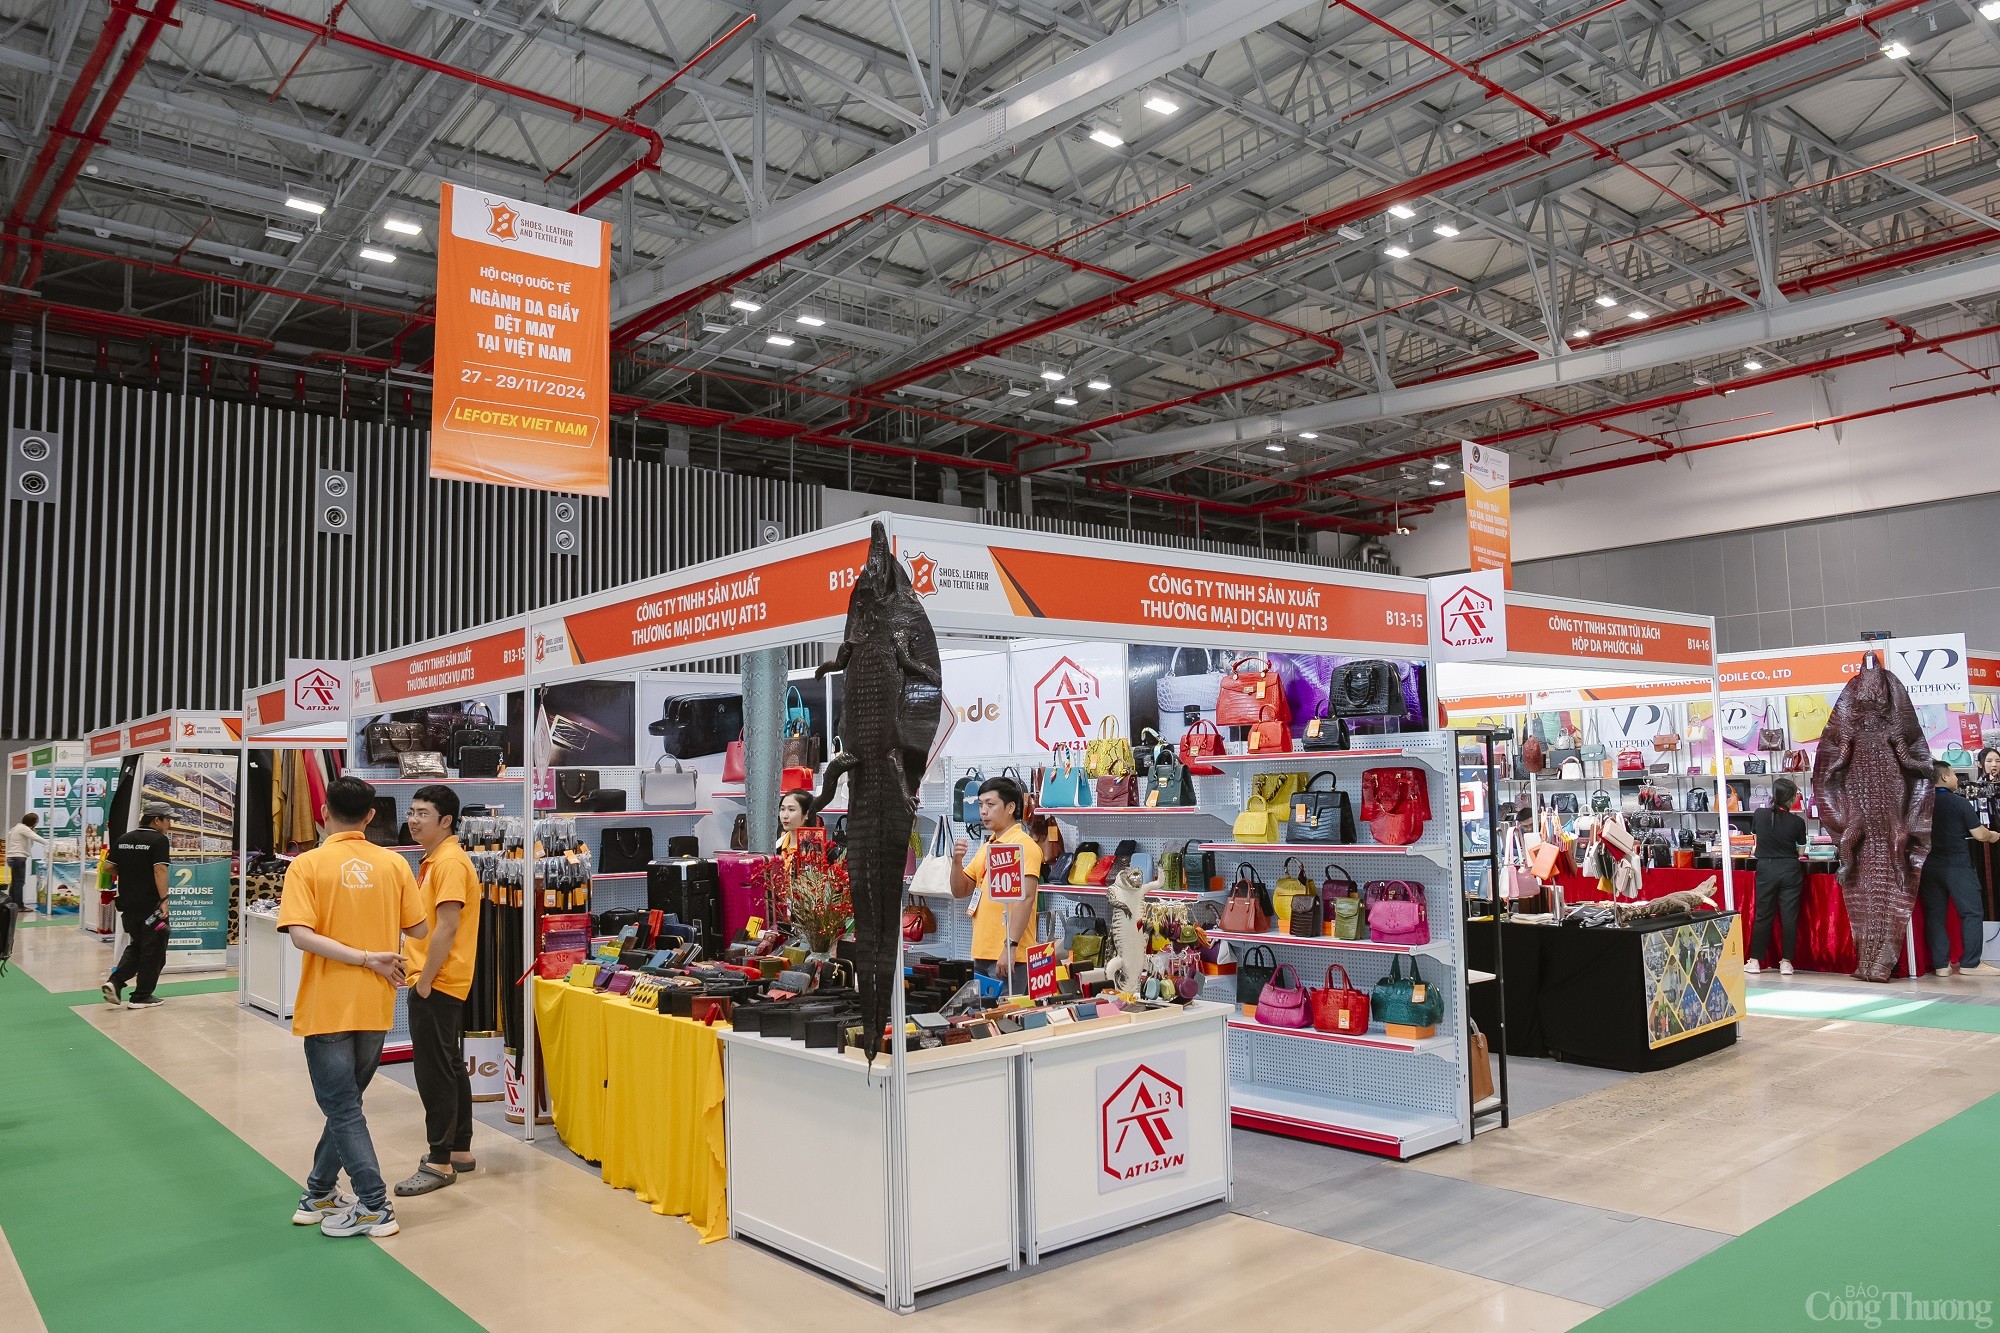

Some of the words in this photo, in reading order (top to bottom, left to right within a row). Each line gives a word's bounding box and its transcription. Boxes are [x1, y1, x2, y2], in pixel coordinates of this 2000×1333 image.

[520, 218, 543, 232] SHOES,
[545, 224, 574, 238] LEATHER
[520, 228, 532, 238] AND
[535, 232, 558, 244] TEXTILE
[559, 237, 574, 247] FAIR
[480, 266, 498, 282] HỘI
[500, 271, 524, 287] CHỢ
[526, 276, 554, 291] QUỐC
[556, 282, 572, 295] TẾ
[470, 288, 521, 312] NGÀNH
[525, 298, 544, 316] DA
[548, 302, 580, 323] GIẦY
[494, 314, 522, 334] DỆT
[526, 320, 556, 339] MAY
[476, 332, 500, 354] TẠI
[504, 338, 534, 358] VIỆT
[538, 344, 572, 363] NAM
[460, 368, 482, 384] 27
[496, 374, 586, 400] 29/11/2024
[454, 406, 520, 428] LEFOTEX
[522, 416, 553, 432] VIET
[554, 421, 588, 437] NAM
[829, 566, 866, 591] B13-
[938, 568, 962, 578] SHOES,
[962, 570, 988, 580] LEATHER
[938, 578, 952, 588] AND
[952, 580, 974, 590] TEXTILE
[976, 582, 989, 591] FAIR
[1148, 572, 1193, 596] CÔNG
[1194, 580, 1213, 598] TY
[1216, 582, 1255, 602] TNHH
[1258, 583, 1285, 605] SẢN
[1288, 587, 1321, 608] XUẤT
[636, 601, 662, 622] CÔNG
[664, 598, 676, 616] TY
[677, 590, 706, 613] TNHH
[708, 582, 729, 606] SẢN
[730, 572, 760, 600] XUẤT
[632, 622, 671, 646] THƯƠNG
[673, 618, 692, 640] MẠI
[694, 612, 720, 637] DỊCH
[720, 609, 736, 631] VỤ
[738, 602, 767, 624] AT13
[1140, 600, 1207, 622] THƯƠNG
[1210, 606, 1238, 628] MẠI
[1241, 608, 1274, 630] DỊCH
[1276, 612, 1294, 633] VỤ
[1297, 614, 1328, 632] AT13
[1386, 610, 1423, 628] B13-15
[1549, 614, 1572, 632] CÔNG
[1572, 620, 1584, 632] TY
[1584, 620, 1606, 634] TNHH
[1608, 624, 1628, 637] SXTM
[1628, 624, 1640, 638] TÚI
[1642, 624, 1660, 640] XÁCH
[1455, 636, 1494, 646] AT13.VN
[1572, 636, 1588, 655] HỘP
[1590, 640, 1602, 653] DA
[1603, 639, 1630, 655] PHƯỚC
[1630, 642, 1644, 656] HẢI
[1687, 638, 1710, 652] B14-16
[409, 660, 424, 675] CÔNG
[424, 659, 431, 671] TY
[430, 656, 446, 670] TNHH
[446, 650, 457, 667] SẢN
[457, 646, 472, 665] XUẤT
[504, 646, 525, 664] B13-15
[1694, 670, 1749, 685] CROODILE
[1750, 670, 1770, 681] CO.,
[1772, 668, 1792, 678] LTD
[1841, 663, 1861, 673] C13
[406, 676, 428, 692] THƯƠNG
[428, 674, 438, 690] MẠI
[438, 672, 452, 689] DỊCH
[452, 671, 460, 686] VỤ
[460, 668, 474, 683] AT13
[1906, 682, 1961, 693] IETPHONG
[1608, 740, 1653, 749] VIETPHON
[991, 851, 1012, 867] SALE
[174, 868, 192, 888] 2
[991, 872, 1020, 893] 40%
[1029, 952, 1042, 962] SALE
[1158, 1091, 1172, 1106] 13
[1124, 1153, 1184, 1180] AT13.VN
